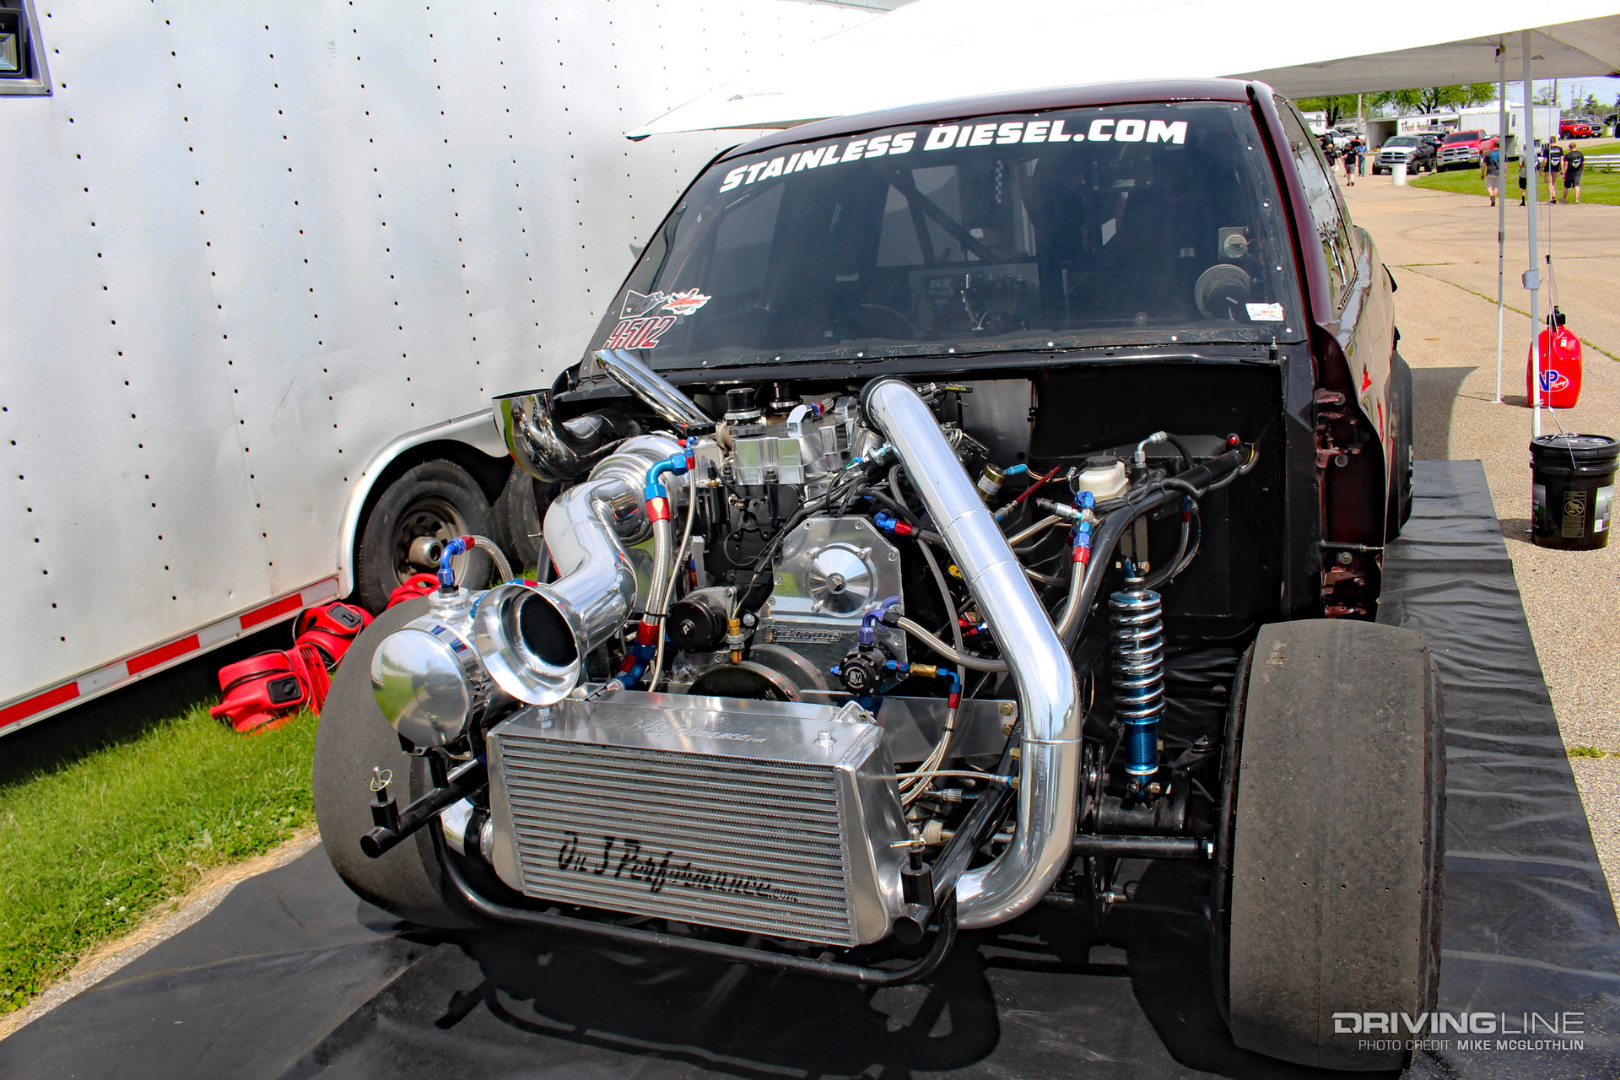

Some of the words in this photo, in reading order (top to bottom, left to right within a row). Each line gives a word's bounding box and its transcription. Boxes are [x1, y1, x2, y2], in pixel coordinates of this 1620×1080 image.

[719, 131, 917, 193] STAINLESS
[923, 119, 1188, 151] DIESEL.COM
[602, 315, 677, 350] 9502
